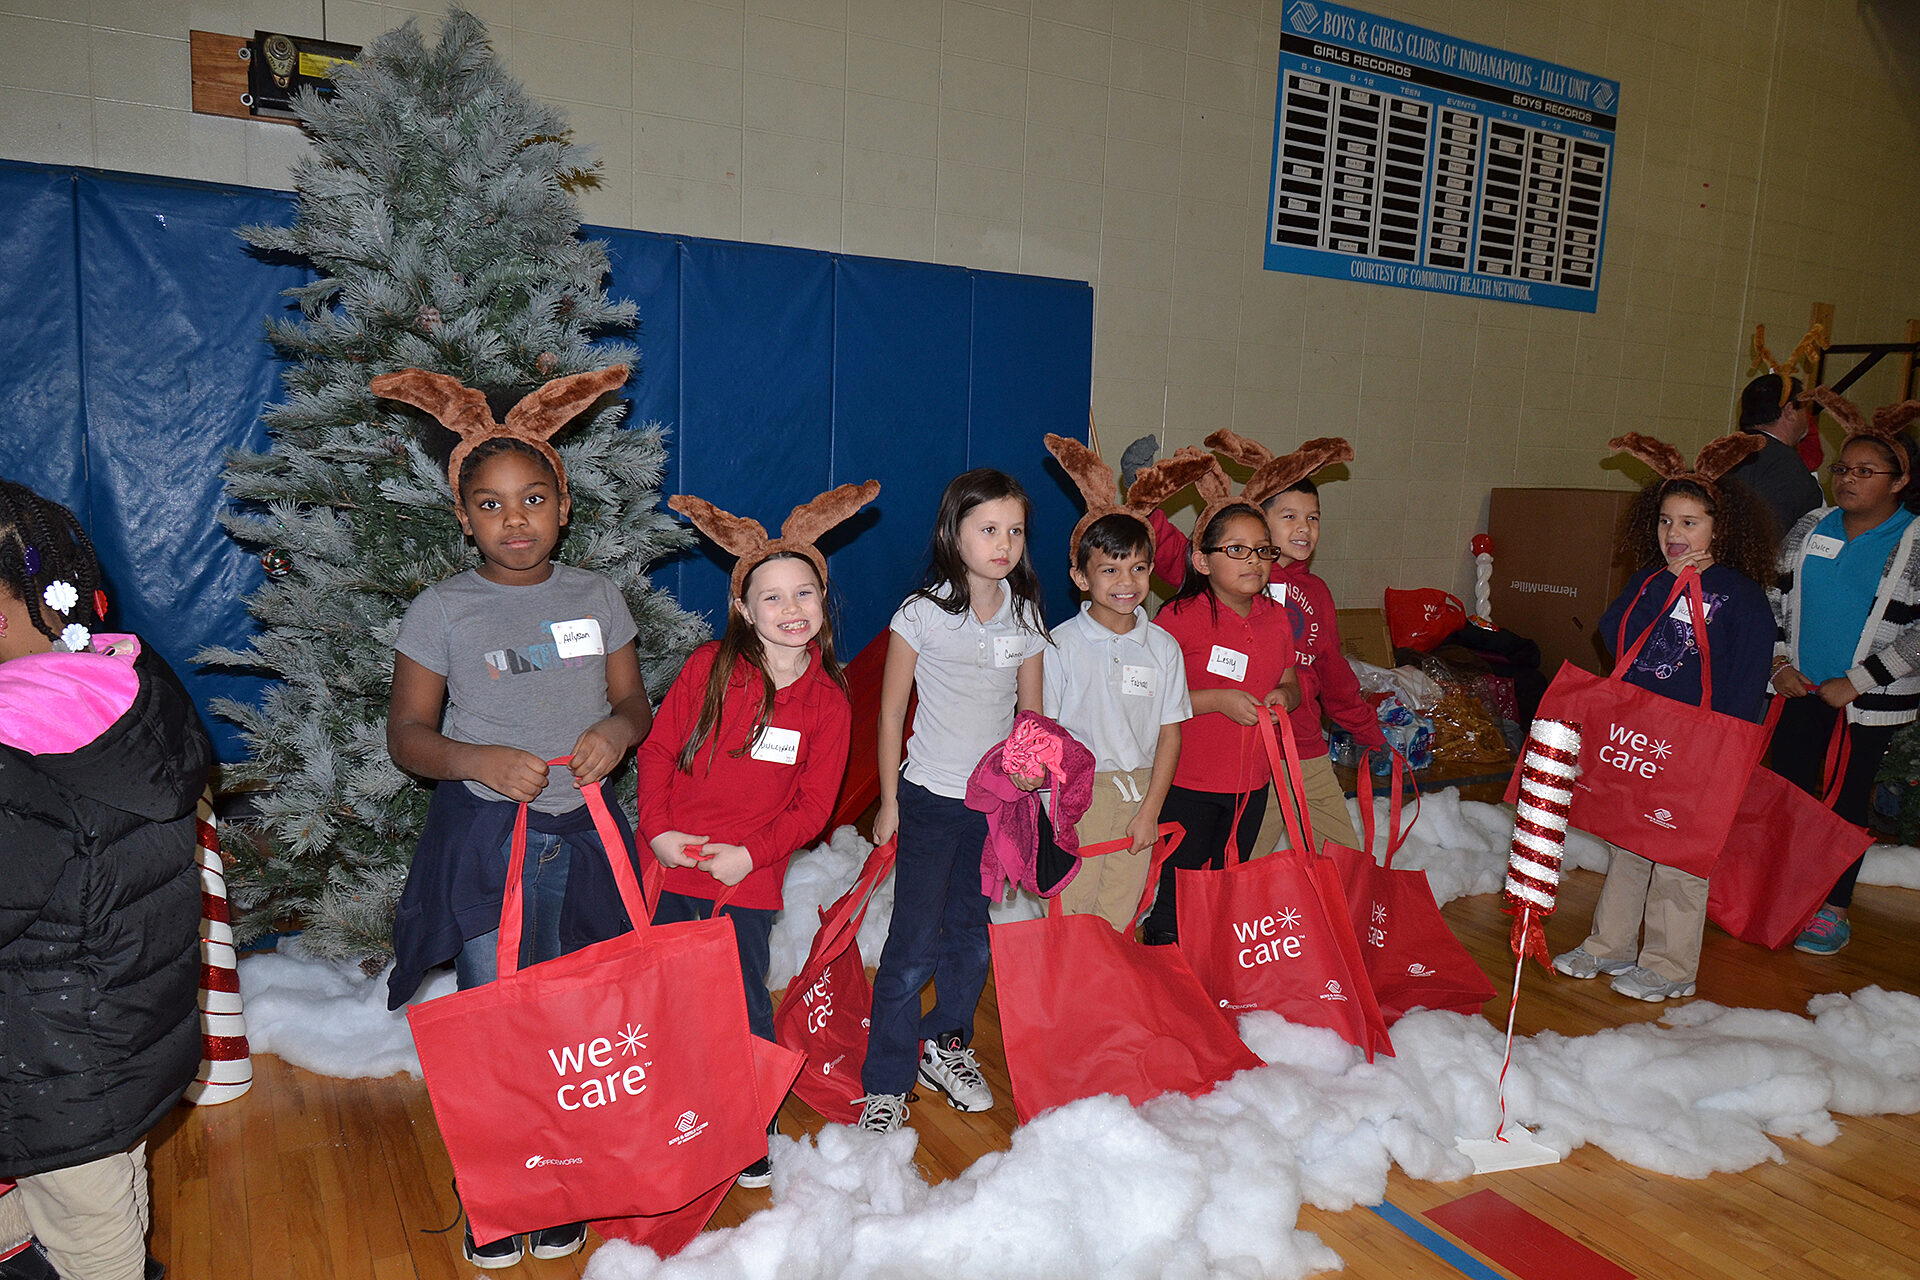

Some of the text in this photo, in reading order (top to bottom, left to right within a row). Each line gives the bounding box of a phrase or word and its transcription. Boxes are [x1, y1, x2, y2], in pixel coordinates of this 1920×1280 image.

[1313, 44, 1412, 78] GIRLS RECORDS
[1322, 11, 1356, 41] BOYS
[1357, 20, 1368, 45] &
[1370, 23, 1404, 54] GIRLS
[1406, 34, 1441, 64] CLUBS
[1442, 43, 1458, 67] OF
[1458, 47, 1533, 87] INDIANAPOLIS
[1539, 68, 1568, 96] LILLY
[1567, 75, 1591, 102] UNIT
[1400, 86, 1421, 98] TEEN
[1446, 97, 1477, 111] EVENTS
[1512, 94, 1593, 123] BOYS RECORDS
[1582, 129, 1600, 140] TEEN
[1350, 259, 1397, 284] COURTESY
[1397, 268, 1410, 285] OF
[1410, 269, 1460, 292] COMMUNITY
[1459, 275, 1492, 295] HEALTH
[1510, 580, 1578, 598] HermanMiller
[563, 632, 591, 644] Allyson
[1609, 723, 1648, 752] we
[1599, 745, 1657, 779] care
[1232, 915, 1277, 944] we
[1238, 934, 1302, 969] care
[548, 1037, 614, 1076] we
[556, 1064, 647, 1111] care
